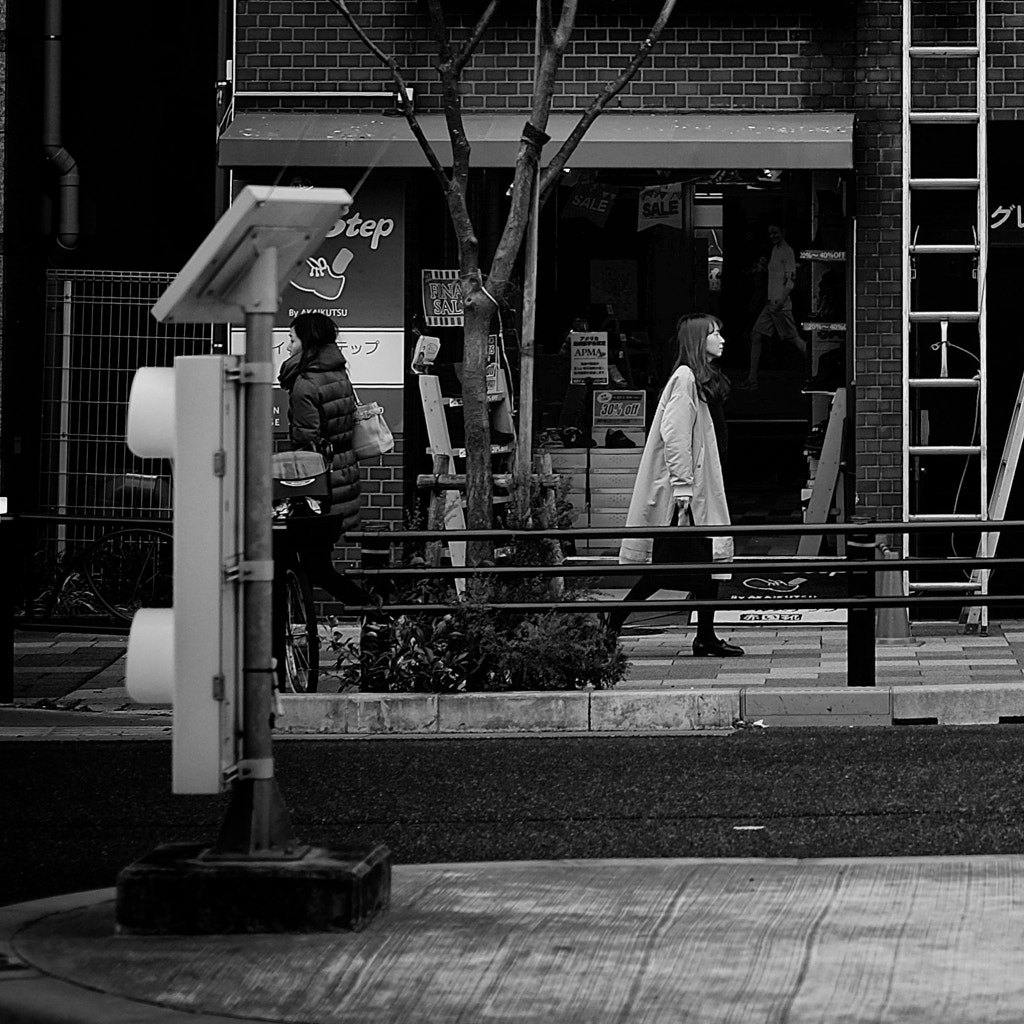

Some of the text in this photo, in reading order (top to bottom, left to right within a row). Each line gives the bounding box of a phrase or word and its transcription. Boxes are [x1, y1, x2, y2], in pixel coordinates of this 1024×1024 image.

[572, 194, 609, 213] SALE
[642, 200, 679, 217] SALE
[429, 282, 463, 300] FINA
[288, 308, 299, 318] By
[433, 299, 464, 315] SAL
[574, 348, 602, 357] APMA
[601, 403, 640, 416] 30% off
